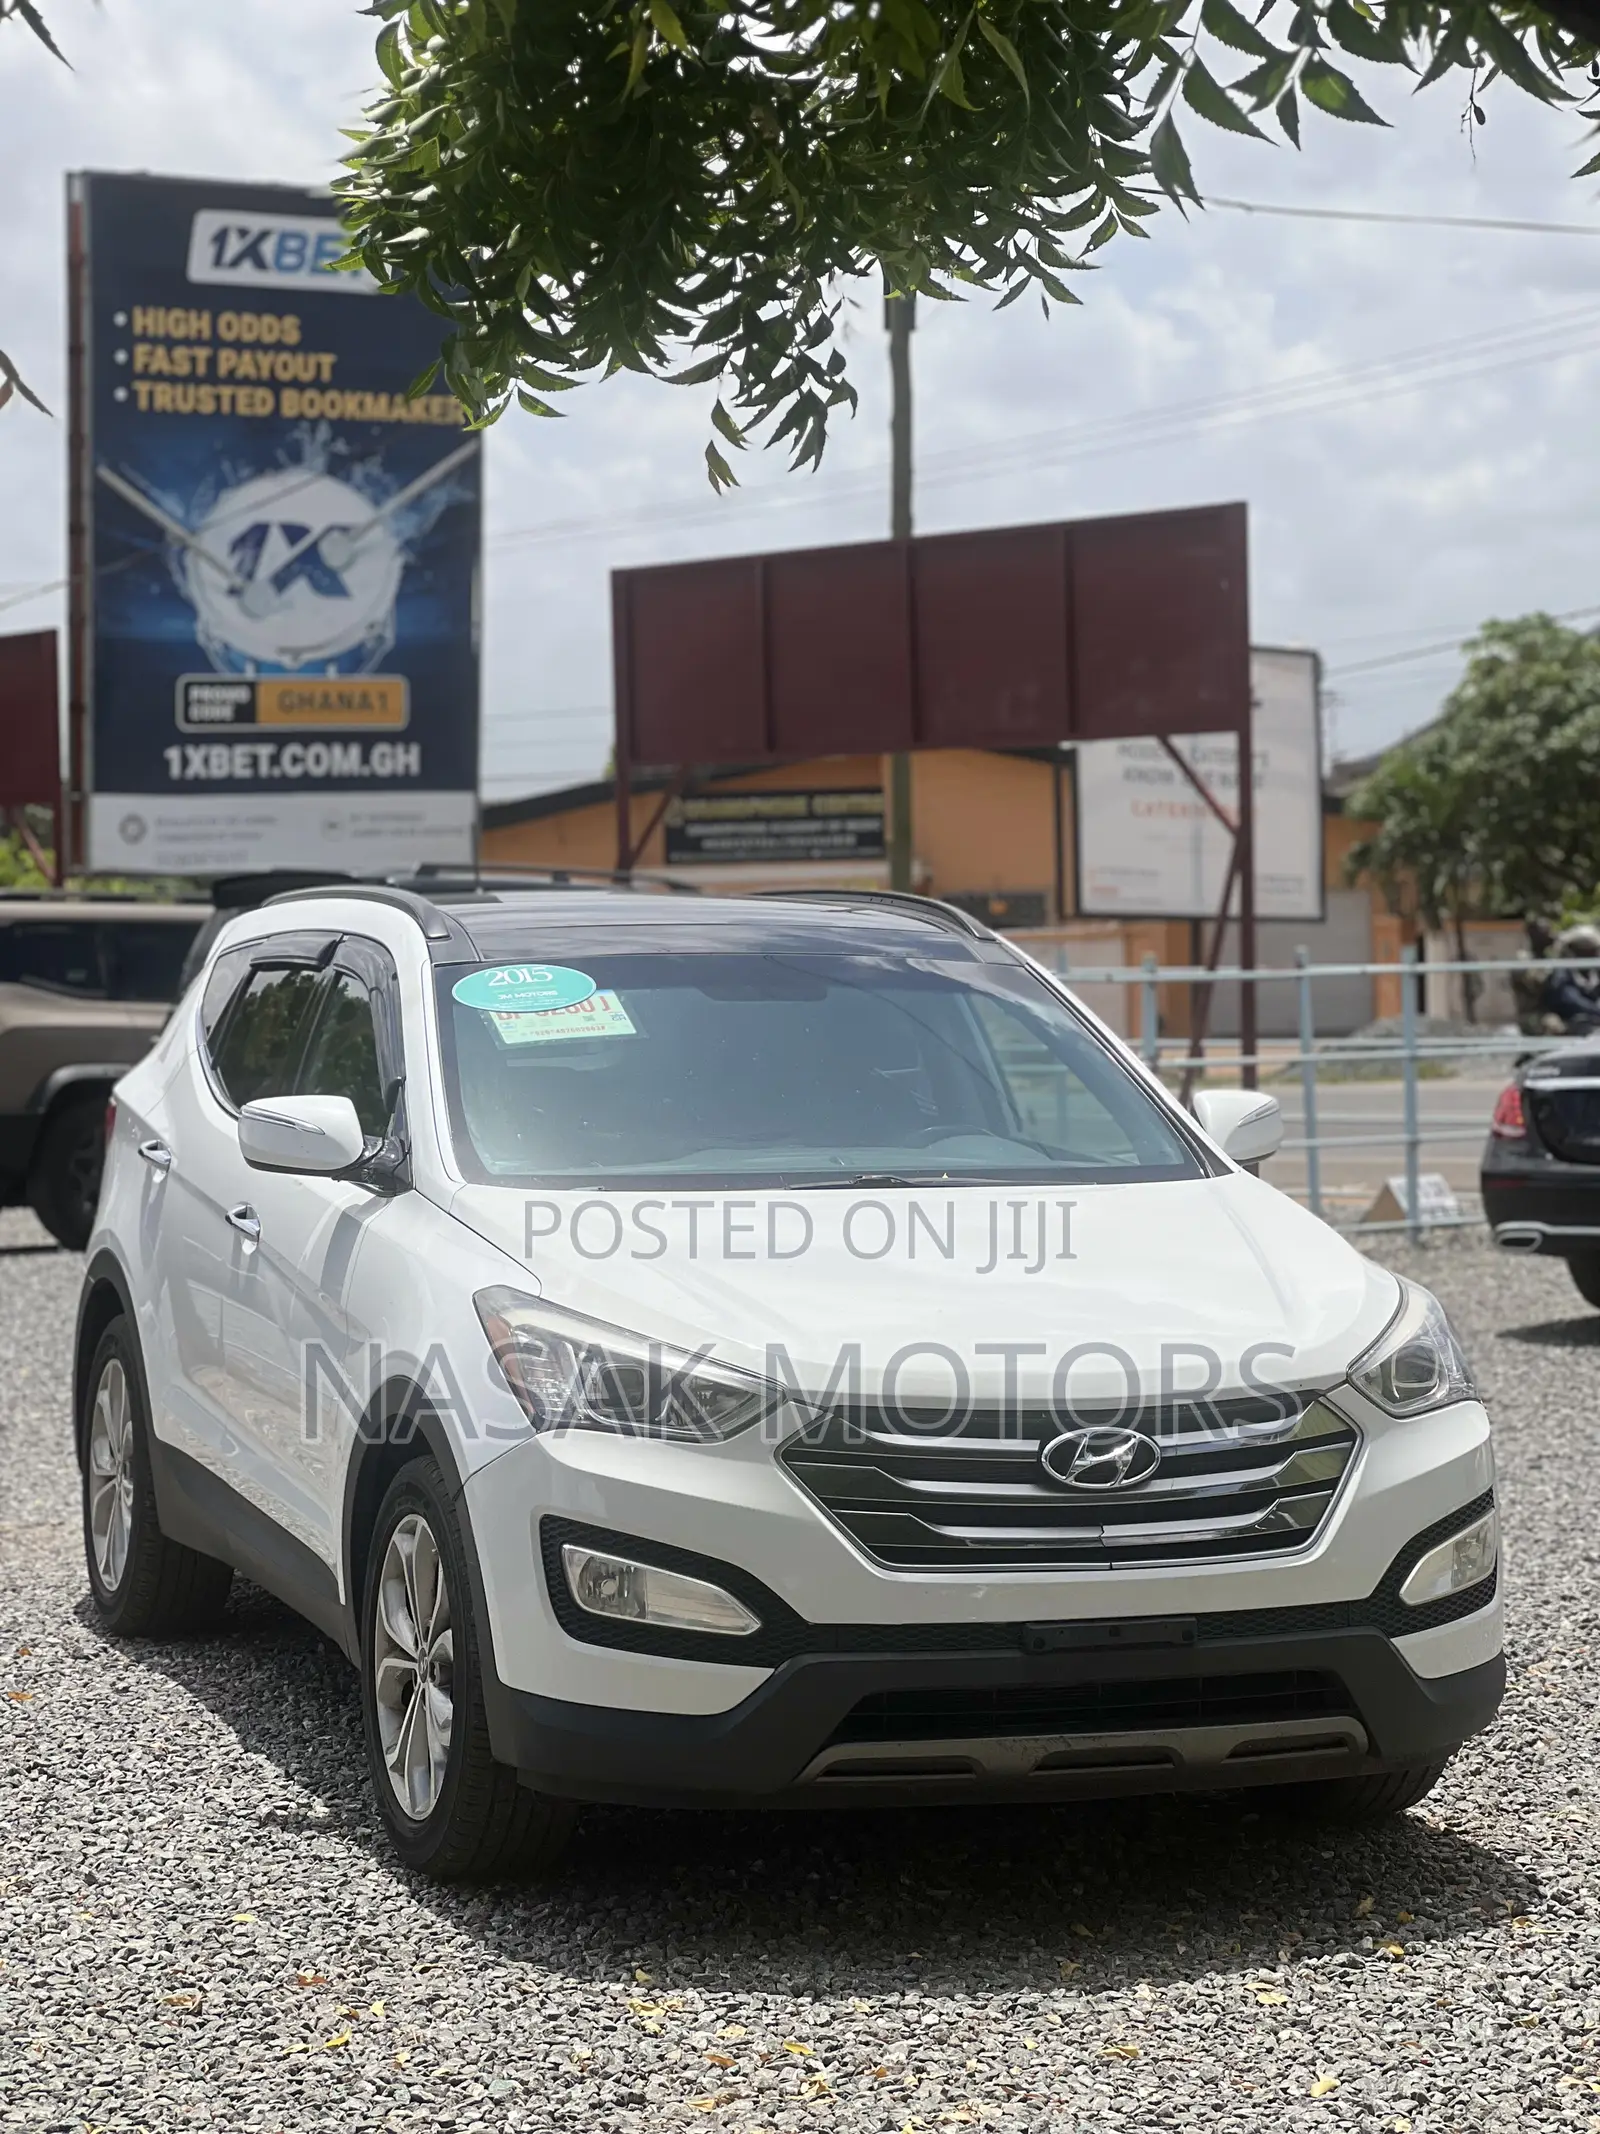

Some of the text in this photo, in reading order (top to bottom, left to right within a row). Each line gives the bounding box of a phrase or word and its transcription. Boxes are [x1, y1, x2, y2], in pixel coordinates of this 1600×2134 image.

[209, 225, 362, 277] 1XBE
[132, 306, 302, 346] HIGH ODDS
[132, 344, 336, 383] FAST PAYOUT
[132, 381, 466, 425] TRUSTED BOOKMAKER
[163, 742, 421, 780] 1XBET.COM.GH
[484, 966, 554, 987] 2015
[515, 990, 559, 999] MOTORS
